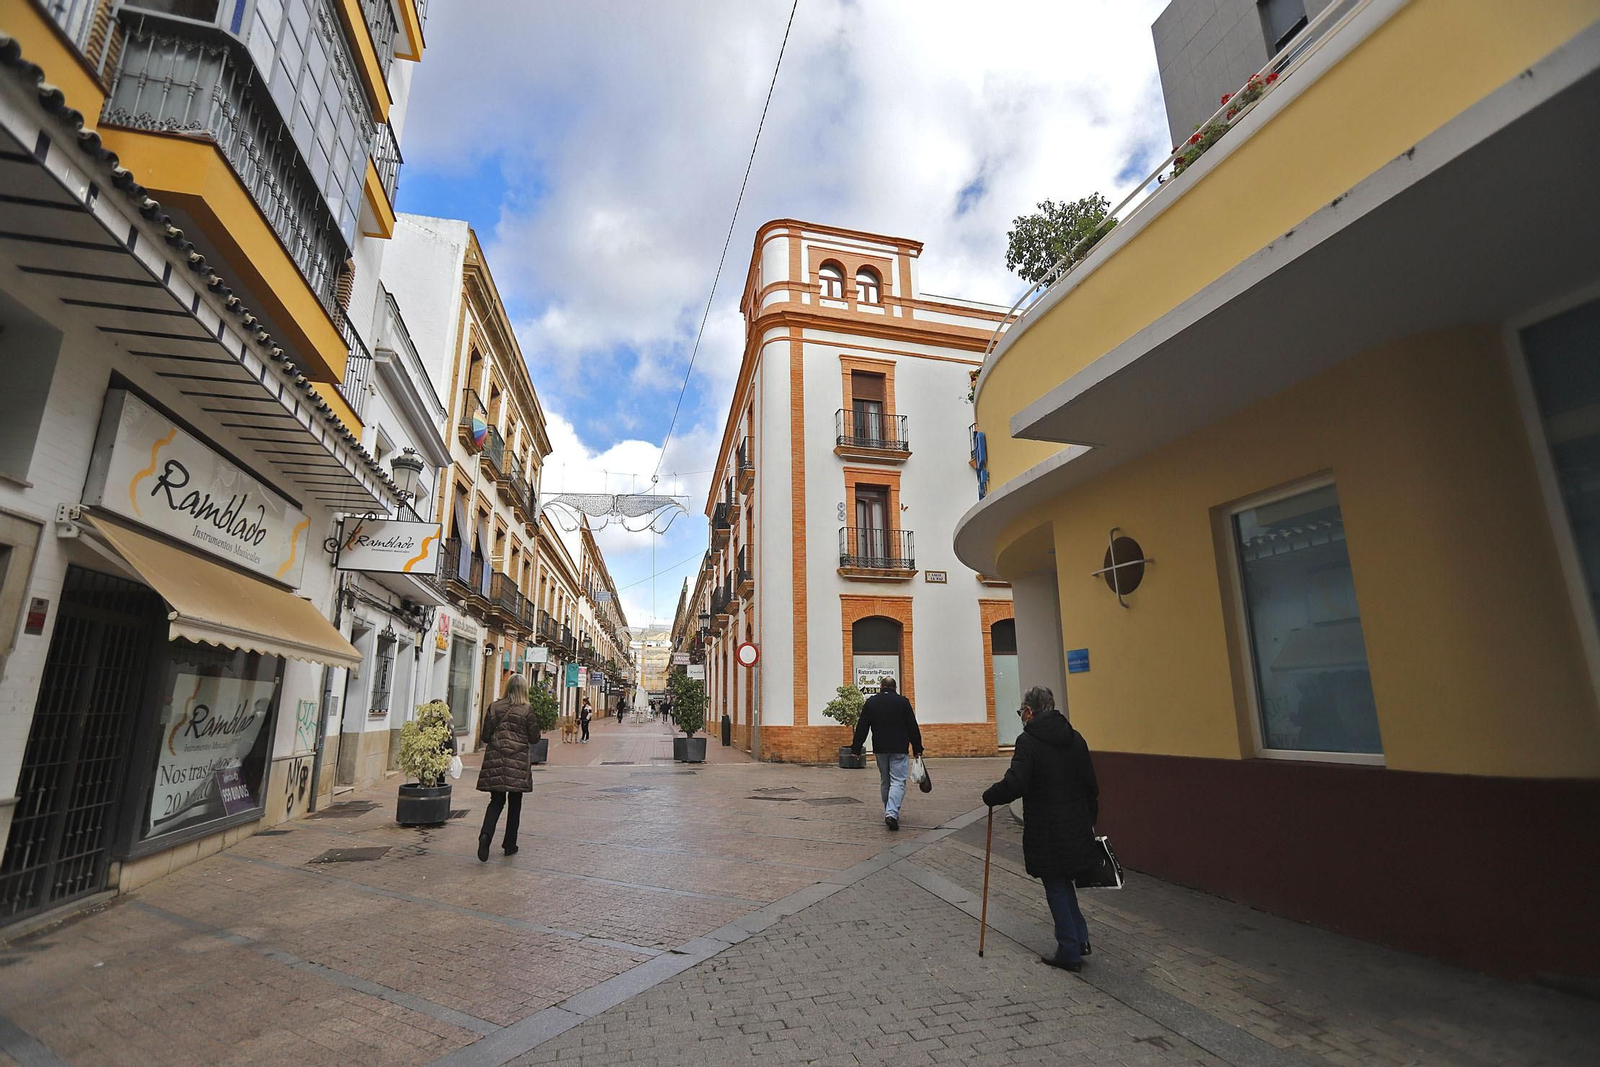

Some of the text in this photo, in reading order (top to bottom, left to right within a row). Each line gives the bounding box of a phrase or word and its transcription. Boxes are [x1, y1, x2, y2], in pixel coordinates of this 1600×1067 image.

[151, 459, 267, 546] Ramblado
[192, 525, 261, 564] Instrumentos Musicales
[354, 535, 415, 549] Ramblado
[159, 764, 187, 787] Nos
[163, 792, 182, 816] 20
